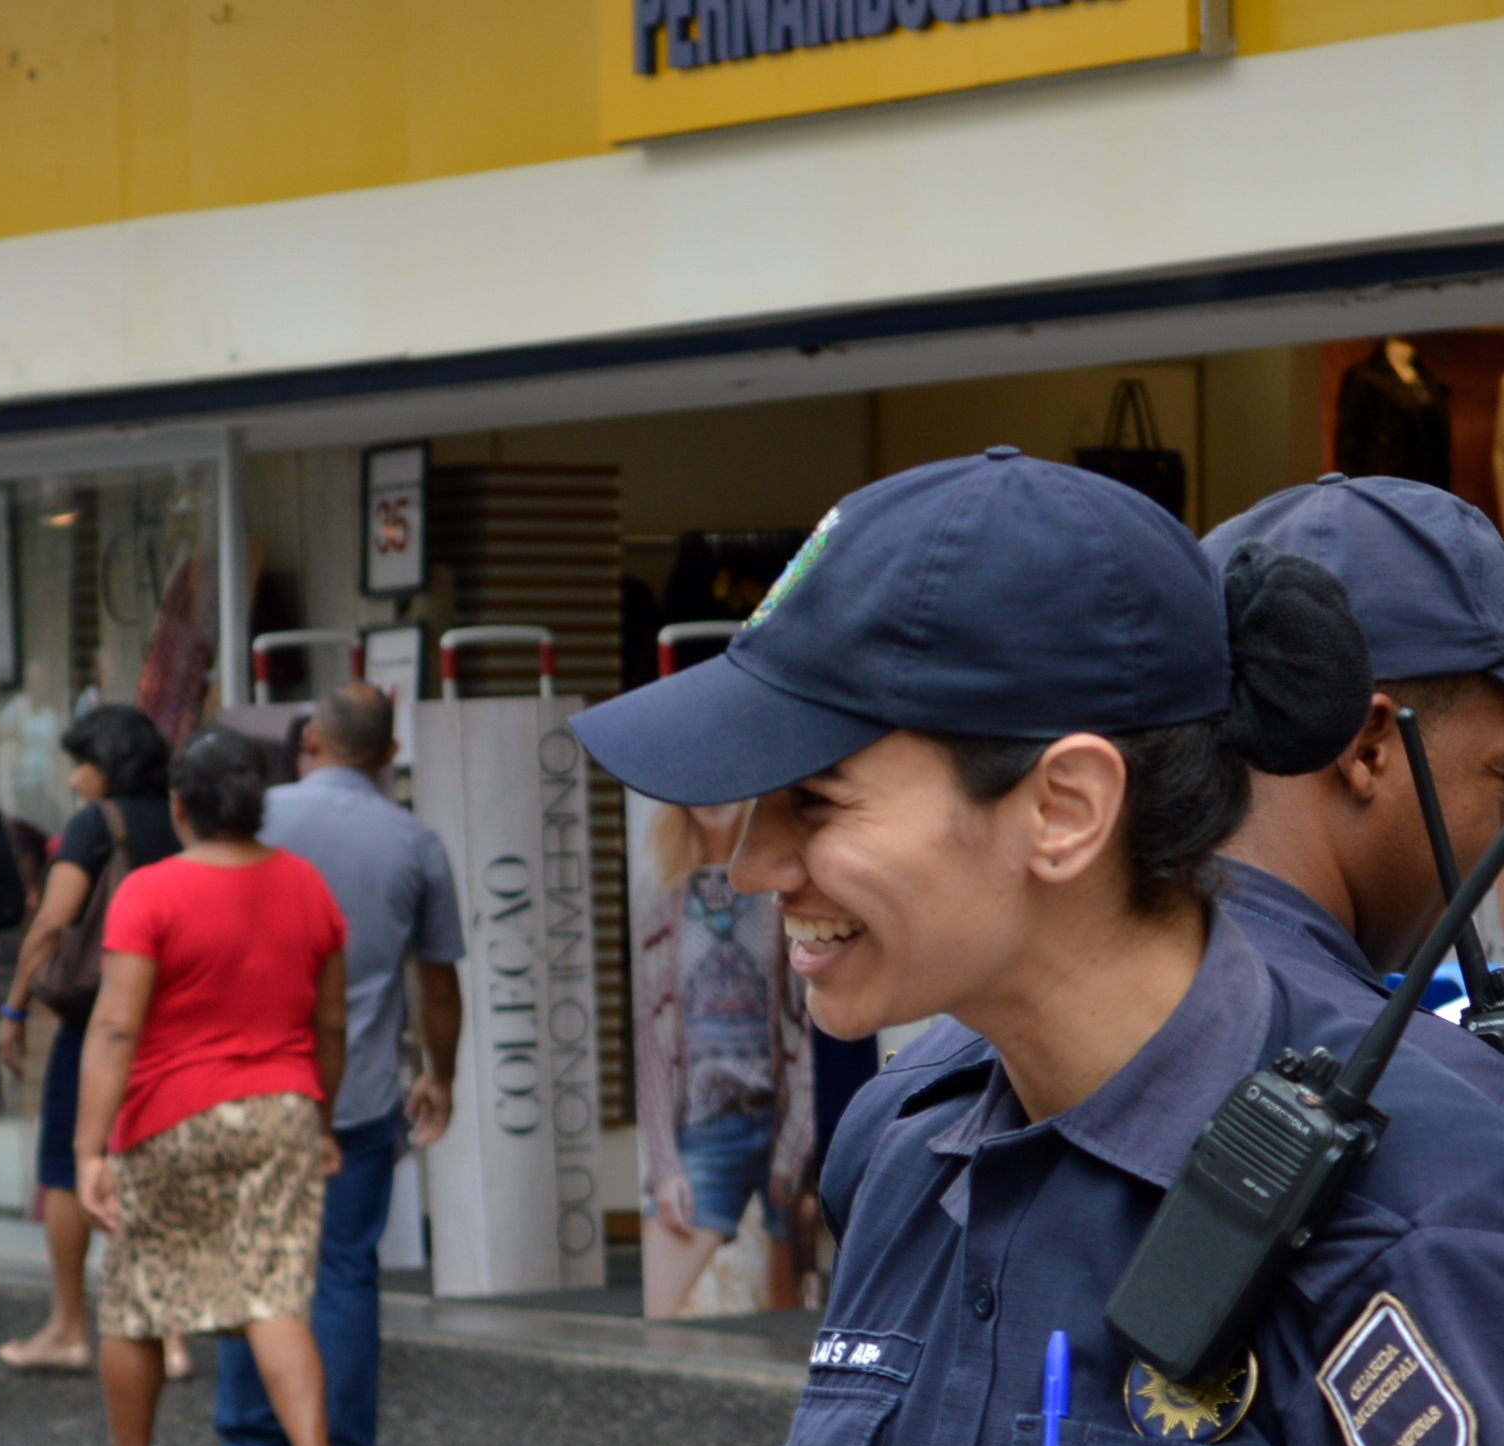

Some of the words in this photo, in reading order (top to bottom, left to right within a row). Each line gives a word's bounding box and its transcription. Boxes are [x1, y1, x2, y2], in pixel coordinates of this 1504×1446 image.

[538, 727, 587, 980] INVERNO
[472, 855, 542, 1137] COLEÇÃO
[549, 997, 597, 1258] OUTONO
[1259, 1096, 1311, 1135] MOTOROLA
[1350, 1344, 1400, 1401] GUARDA
[1352, 1356, 1419, 1431] MUNICIPAL
